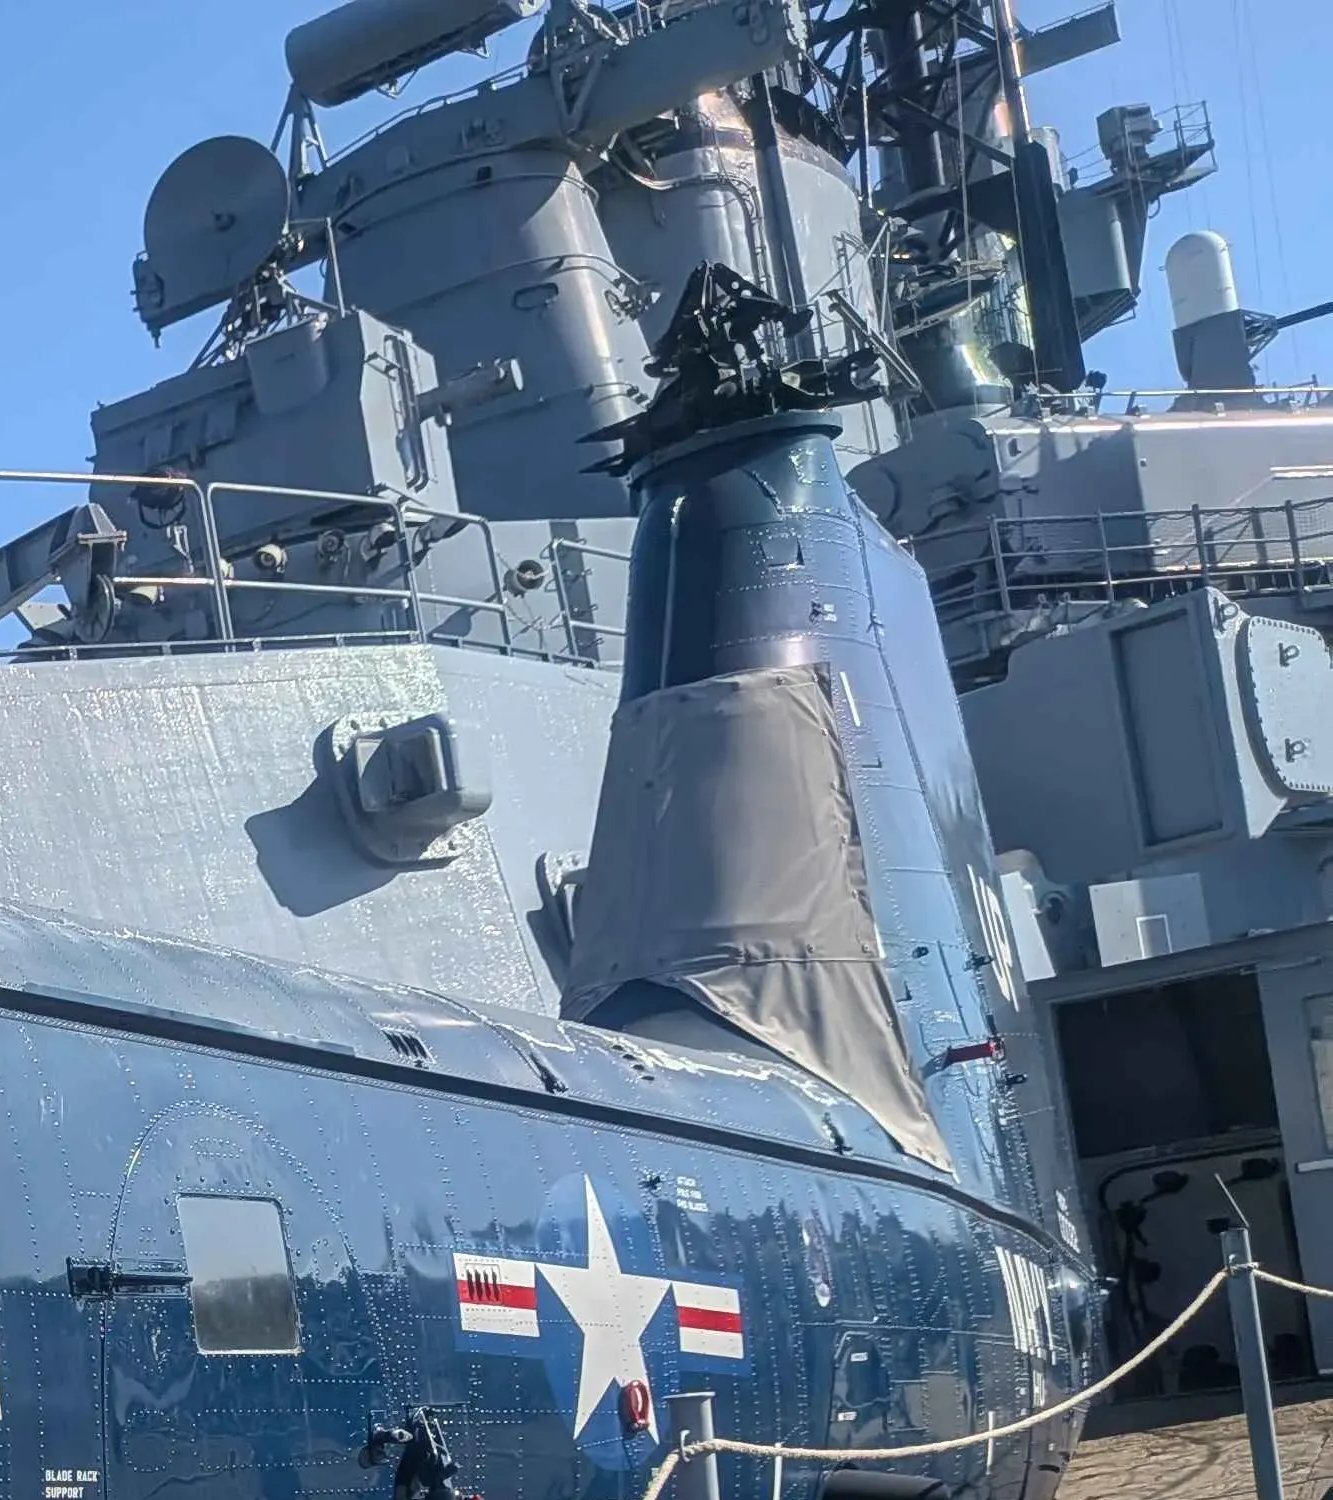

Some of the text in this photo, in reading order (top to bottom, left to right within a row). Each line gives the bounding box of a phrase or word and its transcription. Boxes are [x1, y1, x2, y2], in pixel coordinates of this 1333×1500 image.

[45, 1469, 98, 1482] BLADE RACK
[45, 1486, 84, 1499] SUPPORT
